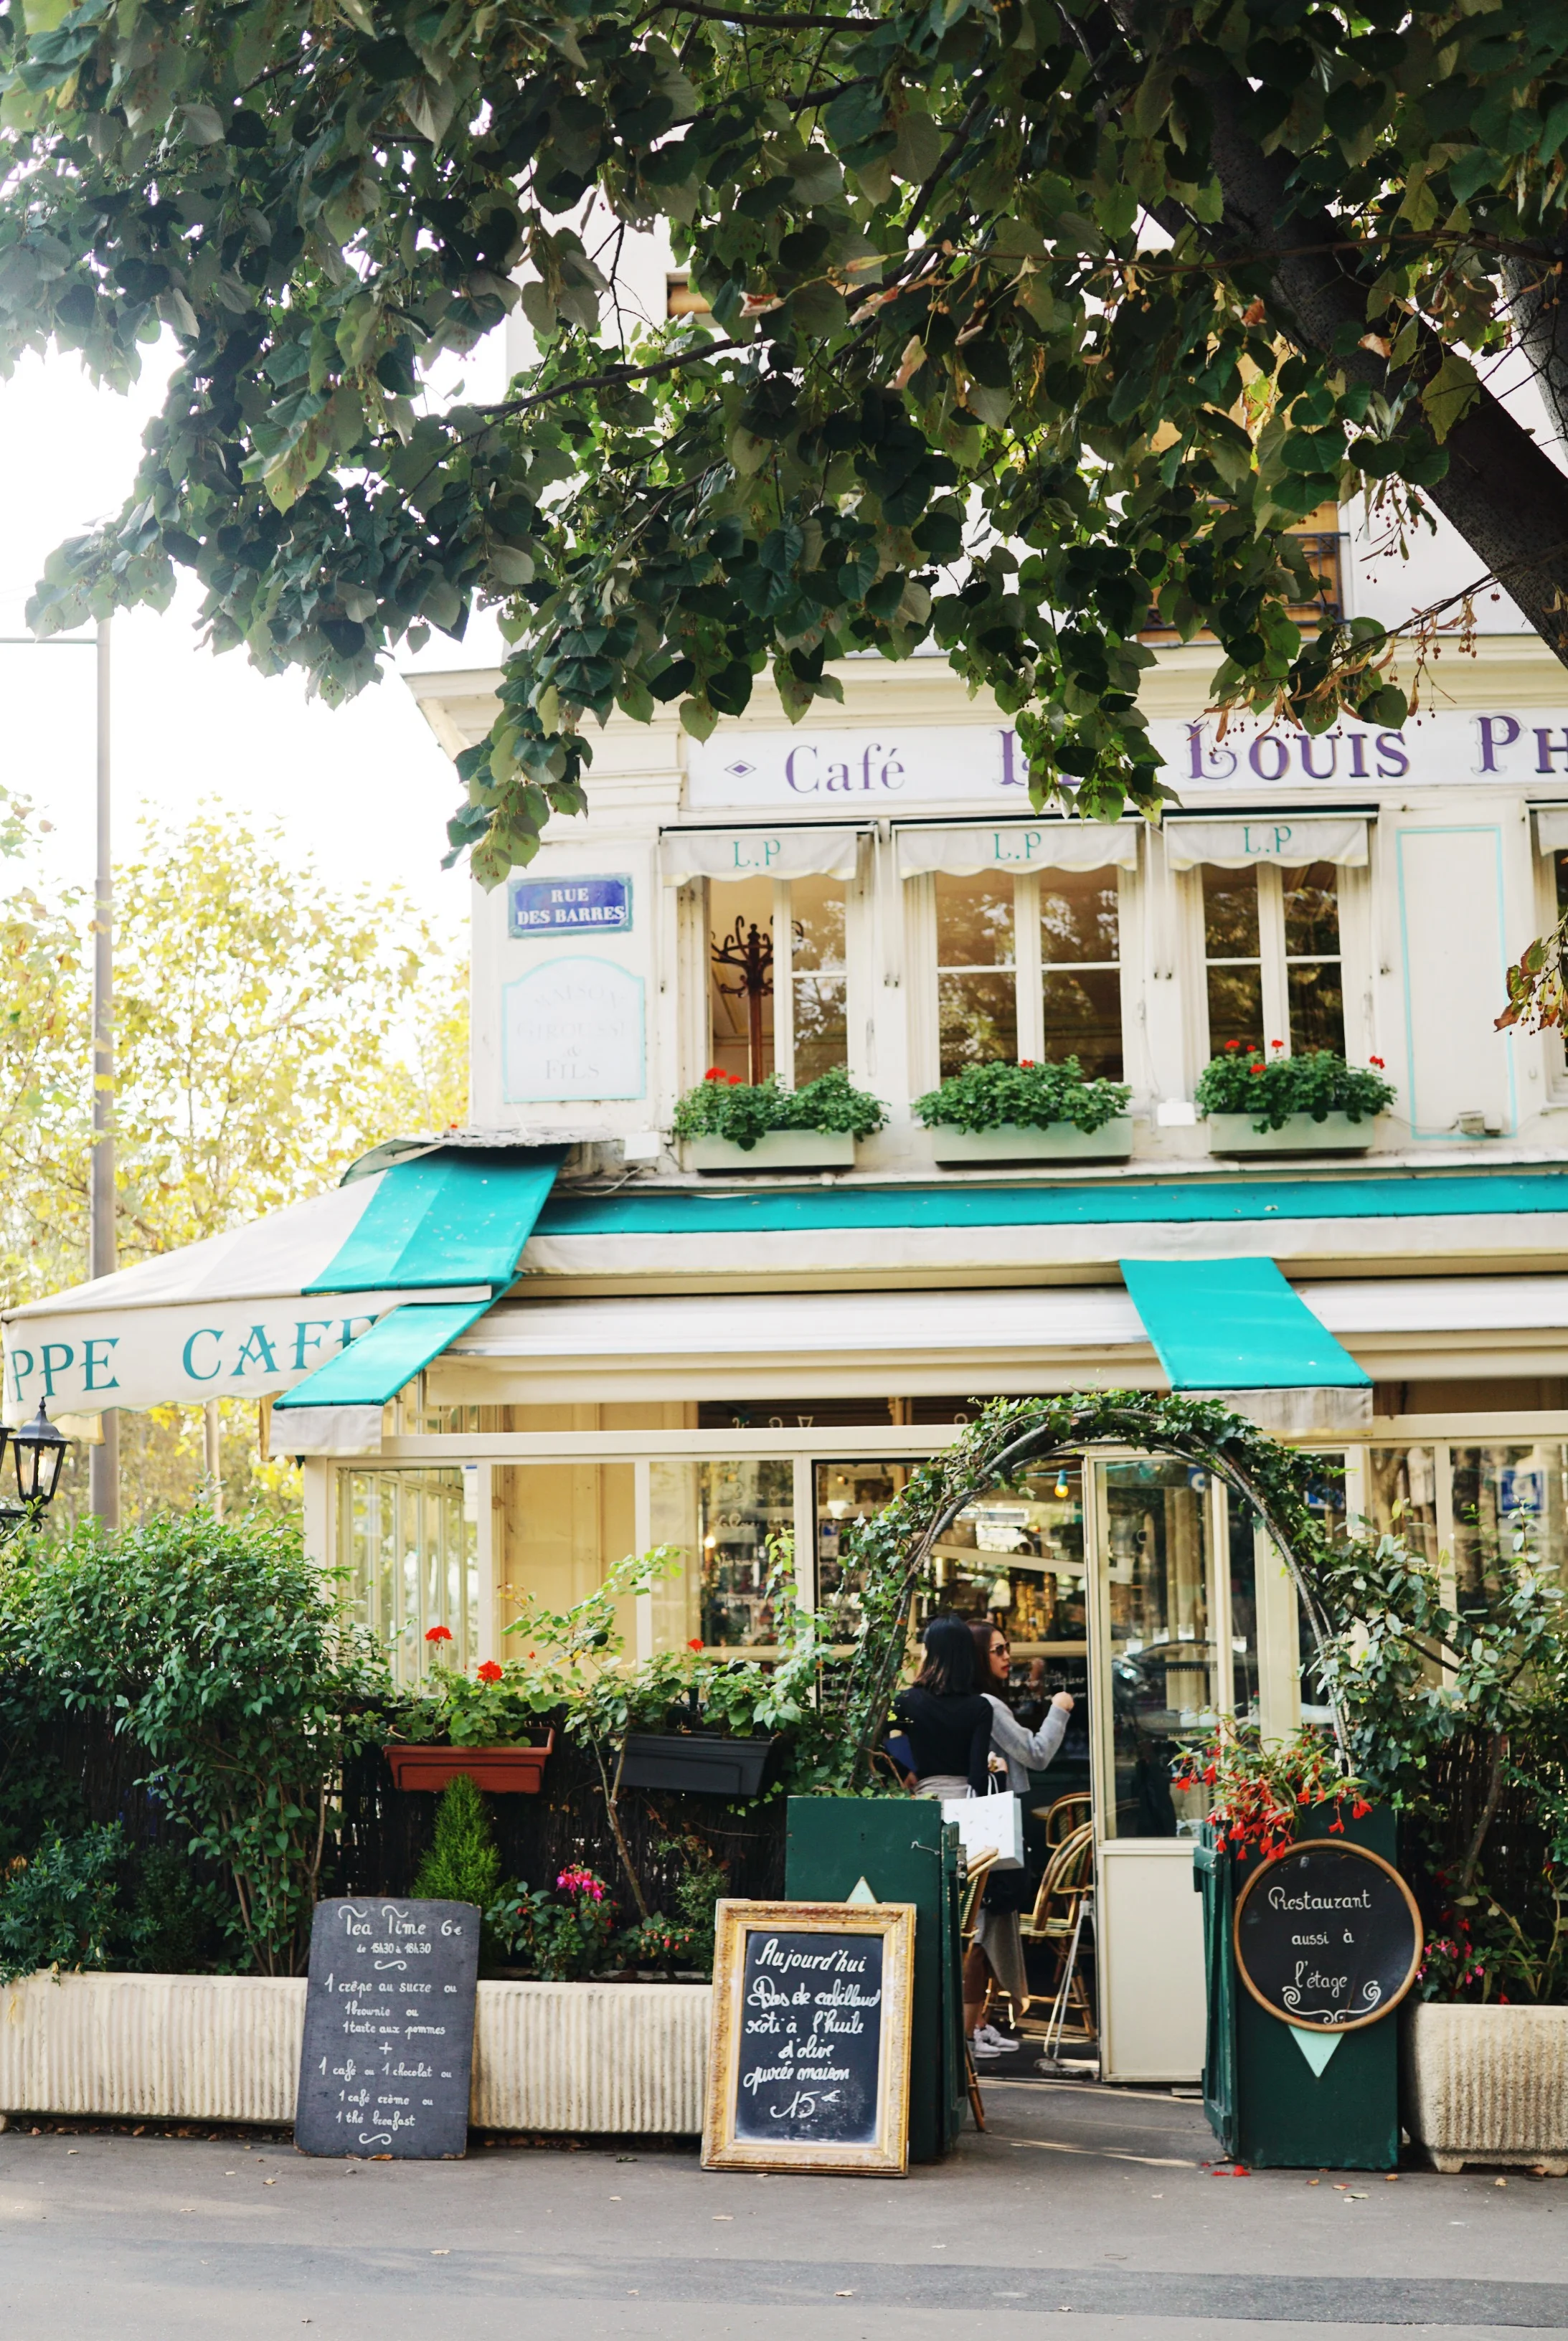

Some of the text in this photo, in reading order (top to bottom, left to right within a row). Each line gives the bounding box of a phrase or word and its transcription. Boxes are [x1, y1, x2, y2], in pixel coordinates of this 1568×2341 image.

[785, 743, 905, 793] Café
[551, 888, 590, 904] RUE
[518, 906, 625, 925] DES BARRES
[1267, 1886, 1371, 1911] Restaurant
[338, 1904, 463, 1936] Tea Time 6€
[1291, 1928, 1355, 1946] aussi à
[356, 1942, 432, 1954] de 15h30 à 18h30
[755, 1938, 867, 1974] Aujourd'hui
[324, 1972, 458, 1999] 1 crêpe au sucre ou
[1294, 1960, 1348, 1998] l'étage
[791, 1982, 811, 2006] de
[405, 2008, 420, 2018] ou
[379, 2025, 400, 2034] aux
[404, 2025, 446, 2040] pommes
[785, 2015, 798, 2034] à
[318, 2056, 327, 2076] 1
[332, 2058, 356, 2082] café
[381, 2062, 390, 2076] 1
[392, 2061, 433, 2078] chocolat
[796, 2061, 851, 2081] maison
[339, 2089, 346, 2102] 1
[347, 2088, 371, 2107] café
[377, 2094, 410, 2106] crème
[336, 2111, 343, 2124] 1
[346, 2109, 364, 2124] thé
